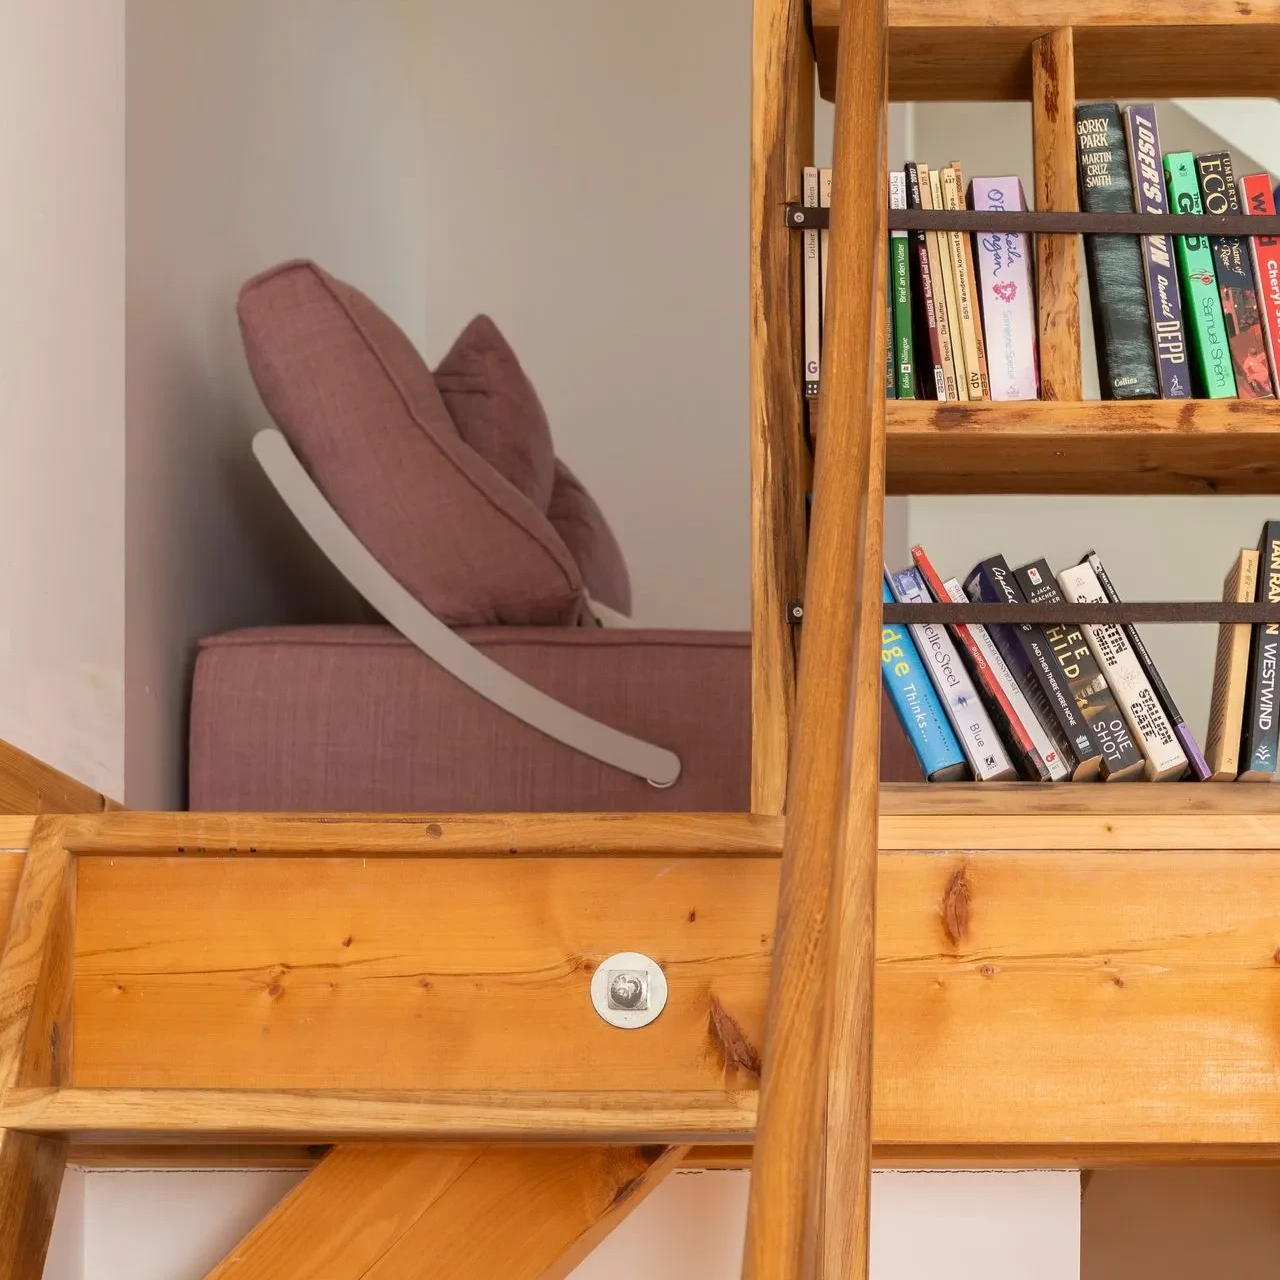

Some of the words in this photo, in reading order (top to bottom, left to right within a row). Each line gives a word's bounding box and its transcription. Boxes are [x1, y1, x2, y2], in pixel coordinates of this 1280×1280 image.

[1077, 118, 1109, 135] GORKY
[1080, 133, 1108, 149] PARK
[1082, 151, 1112, 166] MARTIN
[1087, 164, 1108, 176] CRUZ
[1135, 115, 1162, 203] LOSER'S
[1086, 175, 1111, 188] SMITH
[1200, 158, 1228, 214] ECO
[1222, 158, 1238, 211] UMBERTO
[954, 240, 964, 267] kommst
[956, 269, 968, 302] Wanderer,
[1157, 274, 1175, 319] Daniel
[938, 302, 946, 322] Mutter
[1202, 297, 1220, 347] Samuel
[943, 341, 951, 361] Brecht
[1156, 321, 1184, 364] DEPP
[971, 372, 980, 389] dtv
[1114, 376, 1138, 387] Collins
[1210, 348, 1226, 388] Shem
[1030, 590, 1057, 604] REACHER
[1037, 585, 1051, 595] JACK
[970, 645, 987, 670] Goethe
[1046, 626, 1080, 679] HILD
[1136, 641, 1152, 665] EVERYTHING
[935, 650, 960, 688] Steel
[1009, 680, 1021, 696] LES
[1031, 642, 1042, 657] AND
[1037, 656, 1049, 673] THEN
[1046, 670, 1058, 691] THERE
[1055, 690, 1067, 707] WERE
[1063, 706, 1077, 727] NONE
[1259, 643, 1277, 730] WESTWIND
[903, 684, 929, 743] Thinks...
[1130, 702, 1157, 743] GATE
[1138, 688, 1173, 745] STALLION
[969, 722, 985, 749] Blue
[1093, 721, 1122, 762] SHOT
[1109, 719, 1133, 753] ONE
[1045, 752, 1056, 763] GF
